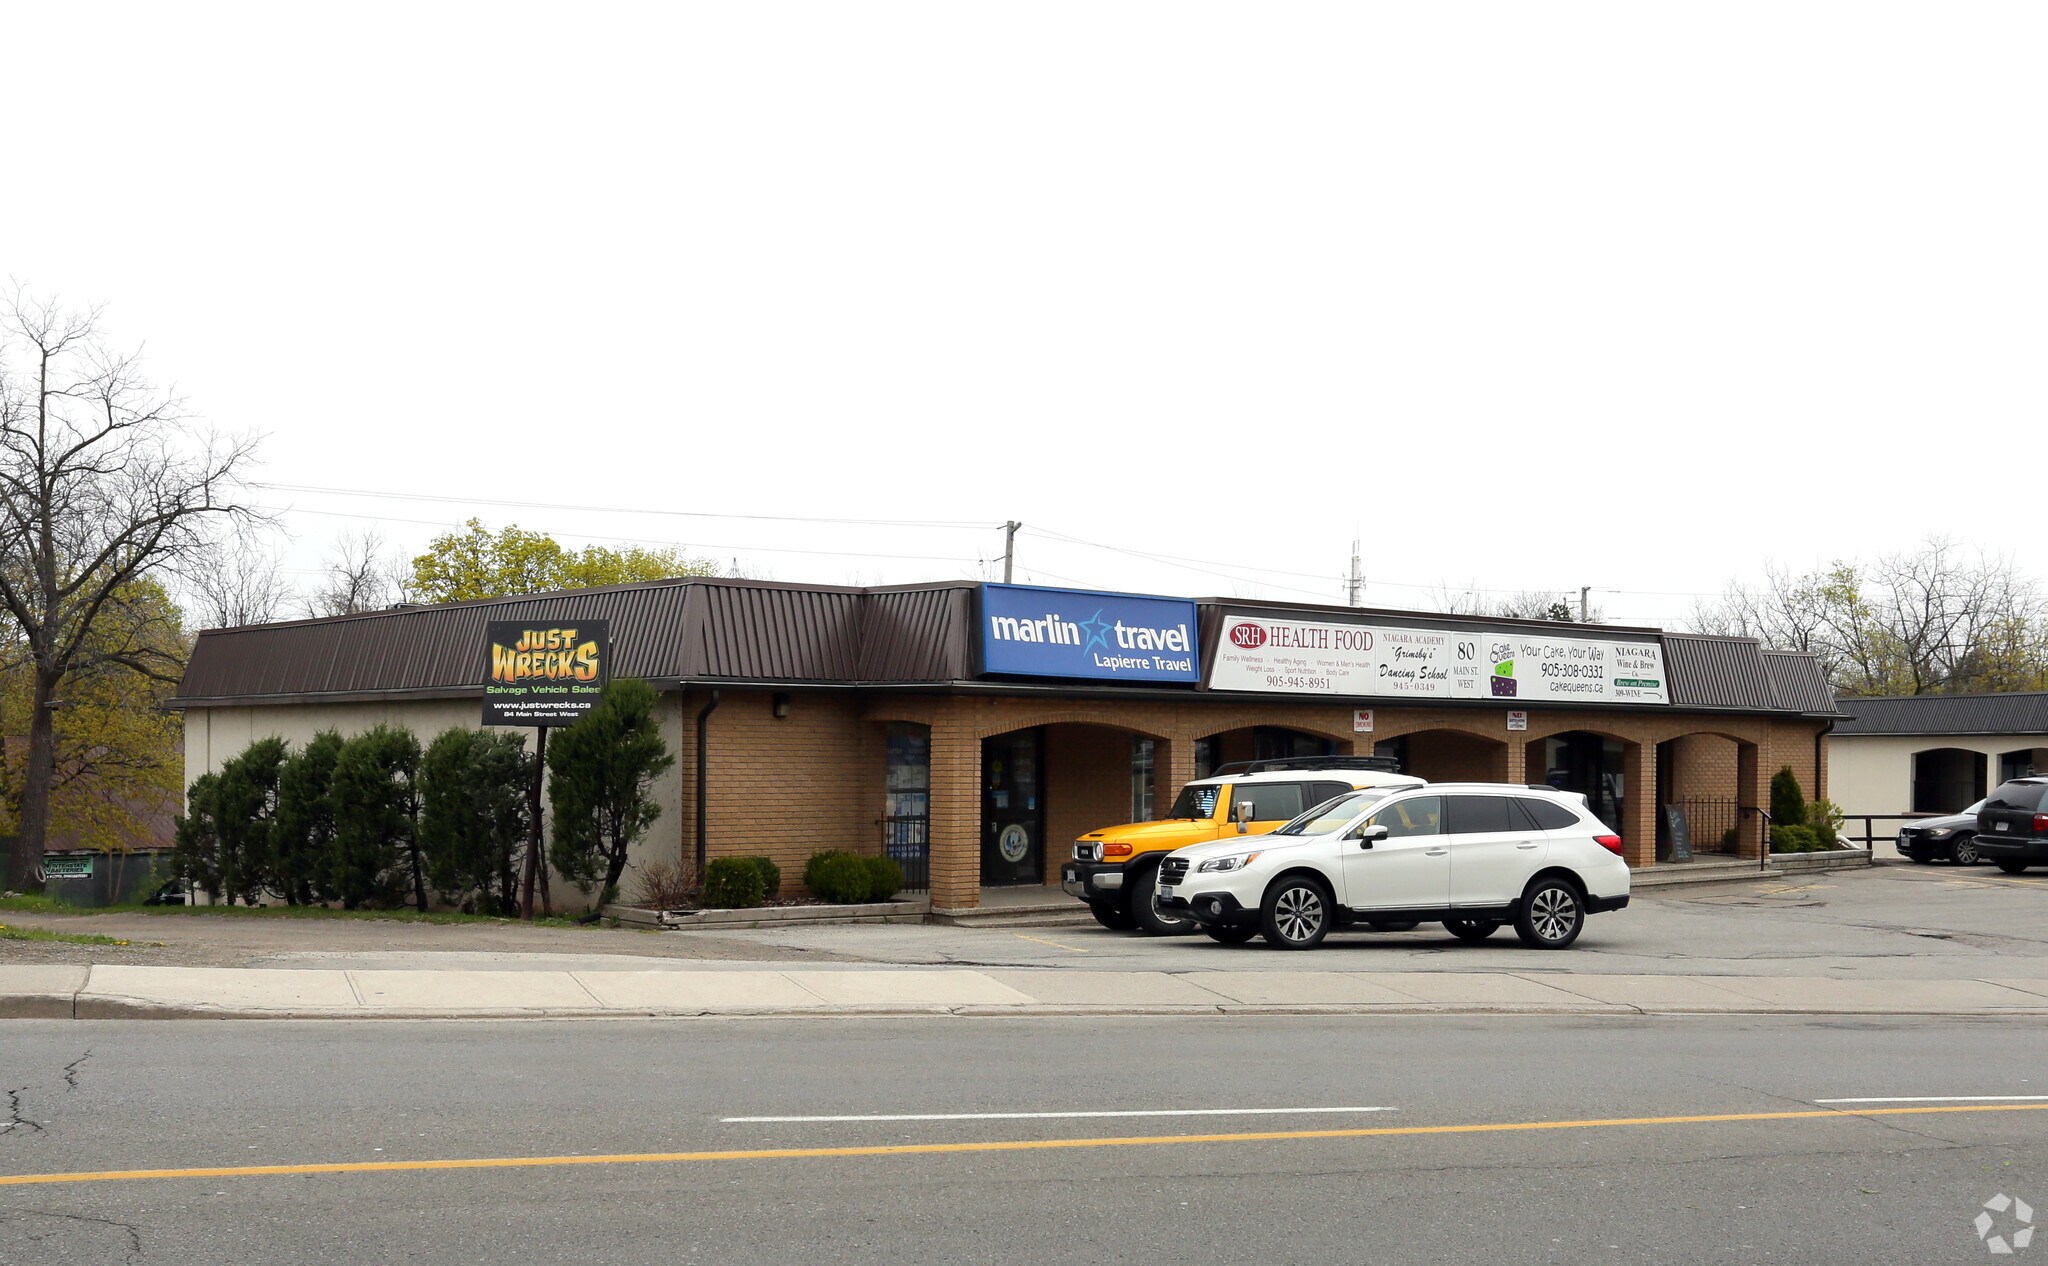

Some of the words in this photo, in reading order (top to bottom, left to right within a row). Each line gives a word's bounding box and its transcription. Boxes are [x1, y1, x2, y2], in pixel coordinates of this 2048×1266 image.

[992, 613, 1080, 646] marlin
[1114, 619, 1190, 652] travel
[1234, 626, 1261, 646] SRH
[1270, 626, 1328, 649] HEALTH
[1335, 630, 1373, 651] FOOD
[1383, 633, 1412, 643] NIAGARA
[1415, 636, 1445, 645] ACADEMY
[516, 629, 577, 651] JUST
[1458, 642, 1475, 660] 80
[1492, 643, 1510, 655] Cake
[1520, 644, 1540, 658] Your
[1544, 645, 1566, 659] Cake,
[1568, 646, 1586, 659] Your
[1588, 646, 1604, 661] Way
[1616, 647, 1656, 660] NIAGARA
[492, 641, 599, 684] WRECKS
[1094, 652, 1150, 672] Lapierre
[1152, 656, 1192, 672] Travel
[1223, 654, 1239, 663] Family
[1241, 655, 1263, 663] Wellness
[1274, 657, 1292, 665] Healthy
[1293, 658, 1306, 666] Aging
[1317, 659, 1335, 667] Women
[1490, 650, 1515, 664] Queens
[1453, 666, 1469, 675] MAIN
[1542, 663, 1603, 678] 905-308-0331
[1617, 659, 1632, 668] Wine
[1633, 660, 1638, 668] &
[1640, 660, 1654, 669] Brew
[1246, 665, 1263, 673] Weight
[1263, 665, 1275, 673] Loss
[1298, 667, 1316, 675] Nutrition
[1326, 668, 1337, 677] Body
[1380, 664, 1415, 682] Dancing
[1419, 666, 1448, 680] School
[1266, 675, 1330, 689] 905-945-8951
[1393, 682, 1435, 690] 945-0349
[1458, 680, 1474, 688] WEST
[1550, 681, 1603, 694] cakequeens.ca
[486, 686, 528, 696] Salvage
[532, 686, 568, 694] Vehicle
[1615, 689, 1641, 697] 309-WINE
[494, 701, 591, 710] www.justwrecks.ca
